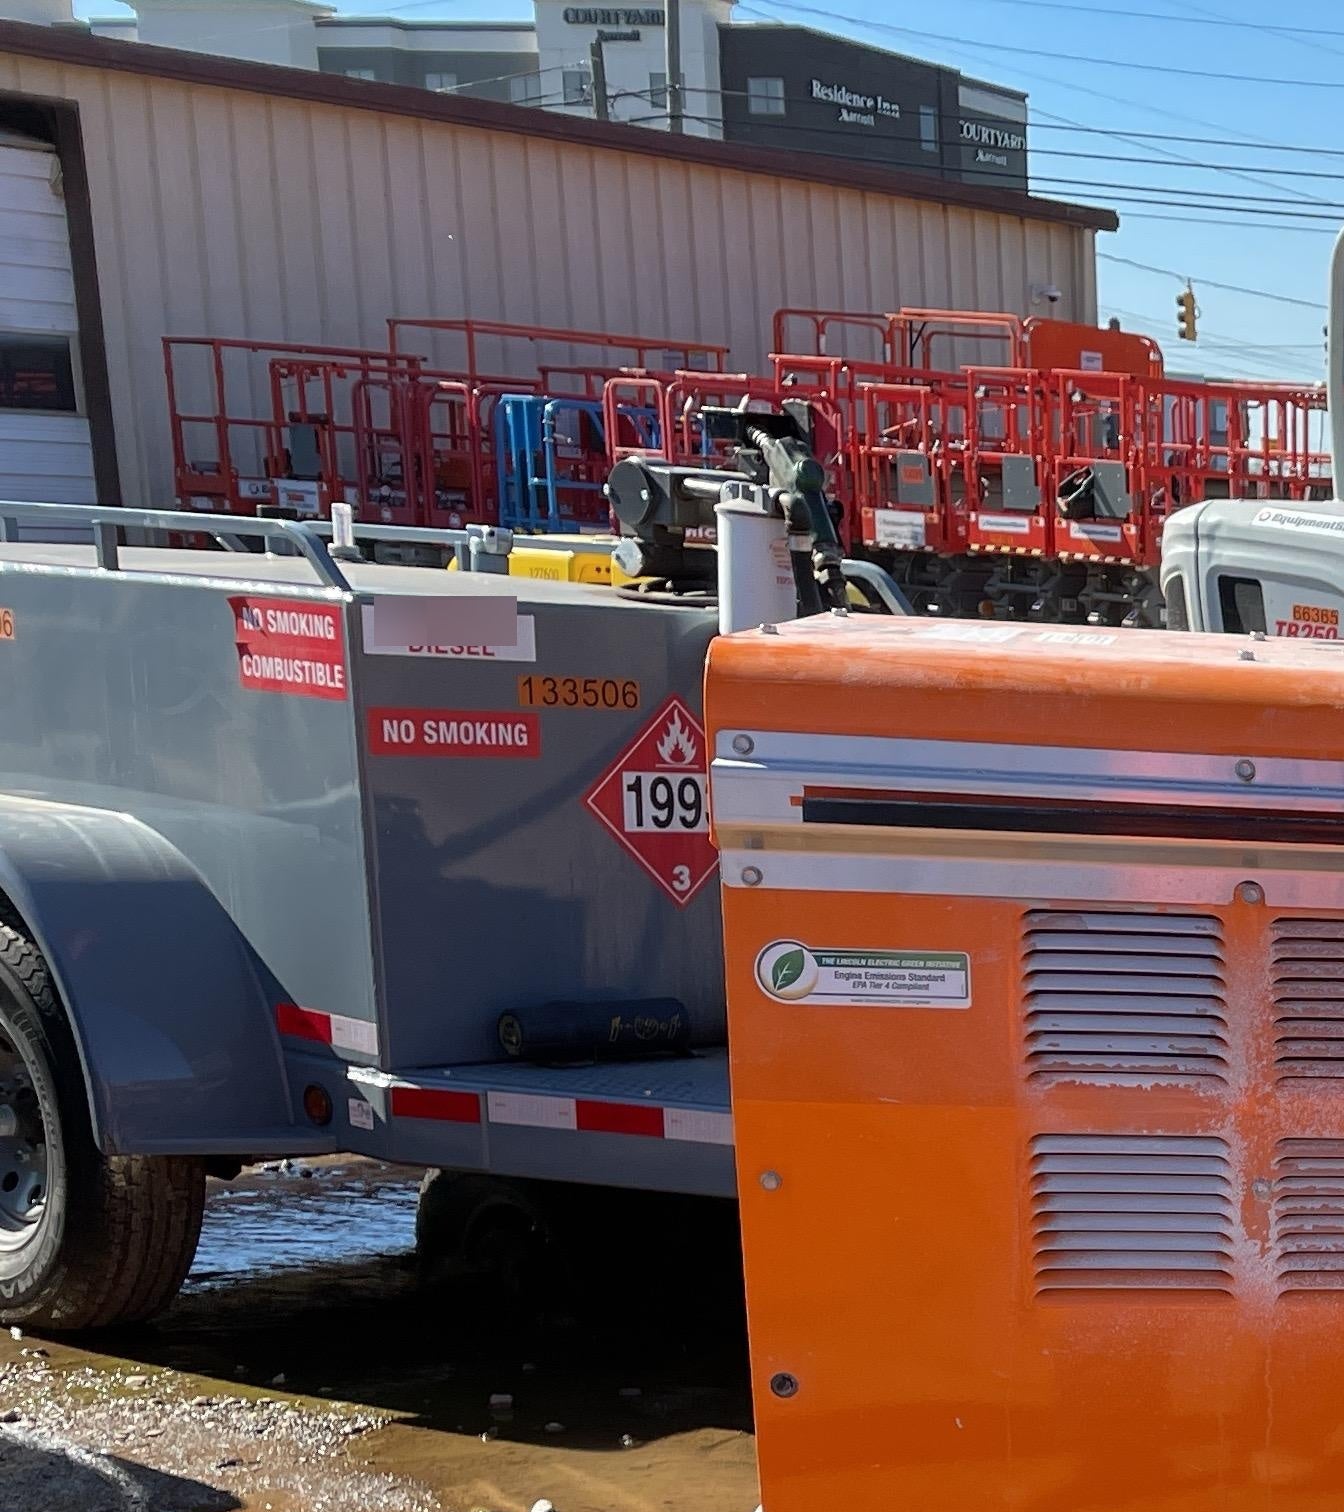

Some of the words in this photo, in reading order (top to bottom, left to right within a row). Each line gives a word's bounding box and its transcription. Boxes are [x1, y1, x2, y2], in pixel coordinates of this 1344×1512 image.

[811, 79, 874, 109] Residence
[267, 609, 335, 640] SMOKING
[242, 654, 344, 689] COMBUSTIBLE
[522, 677, 639, 709] 133506
[382, 718, 415, 744] NO
[423, 720, 529, 747] SMOKING
[626, 775, 711, 829] 199
[671, 864, 692, 892] 3
